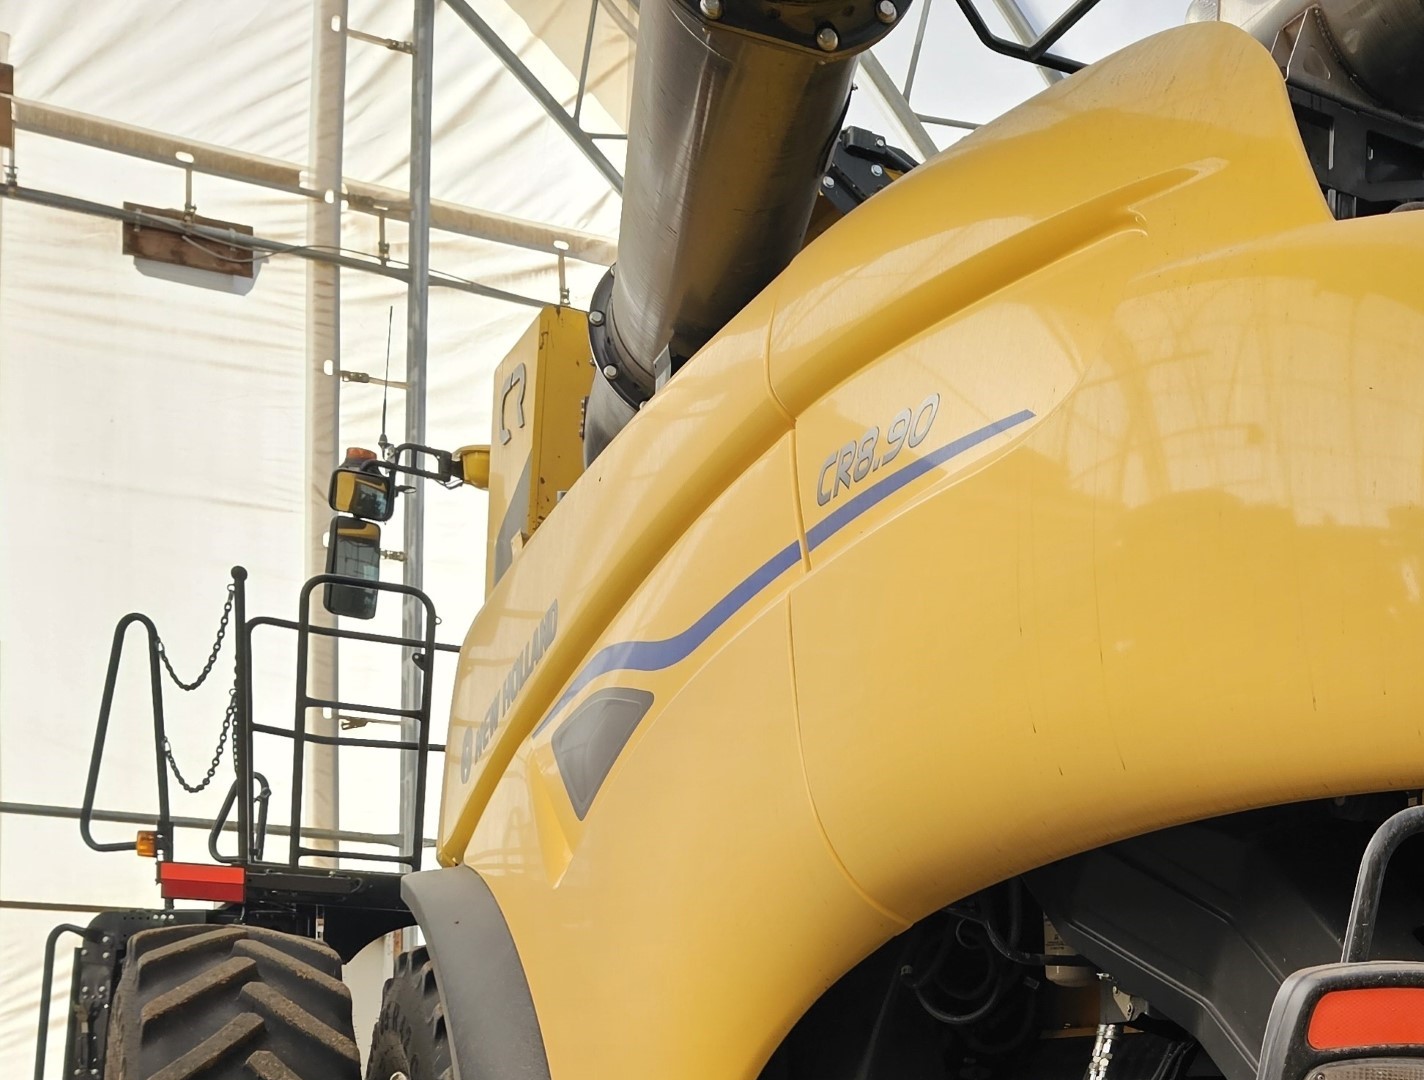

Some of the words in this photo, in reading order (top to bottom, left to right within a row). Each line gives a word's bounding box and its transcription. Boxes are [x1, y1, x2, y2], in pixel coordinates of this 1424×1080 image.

[816, 392, 940, 507] CR8.90
[474, 688, 501, 765] NEW
[502, 598, 558, 718] HOLLAND
